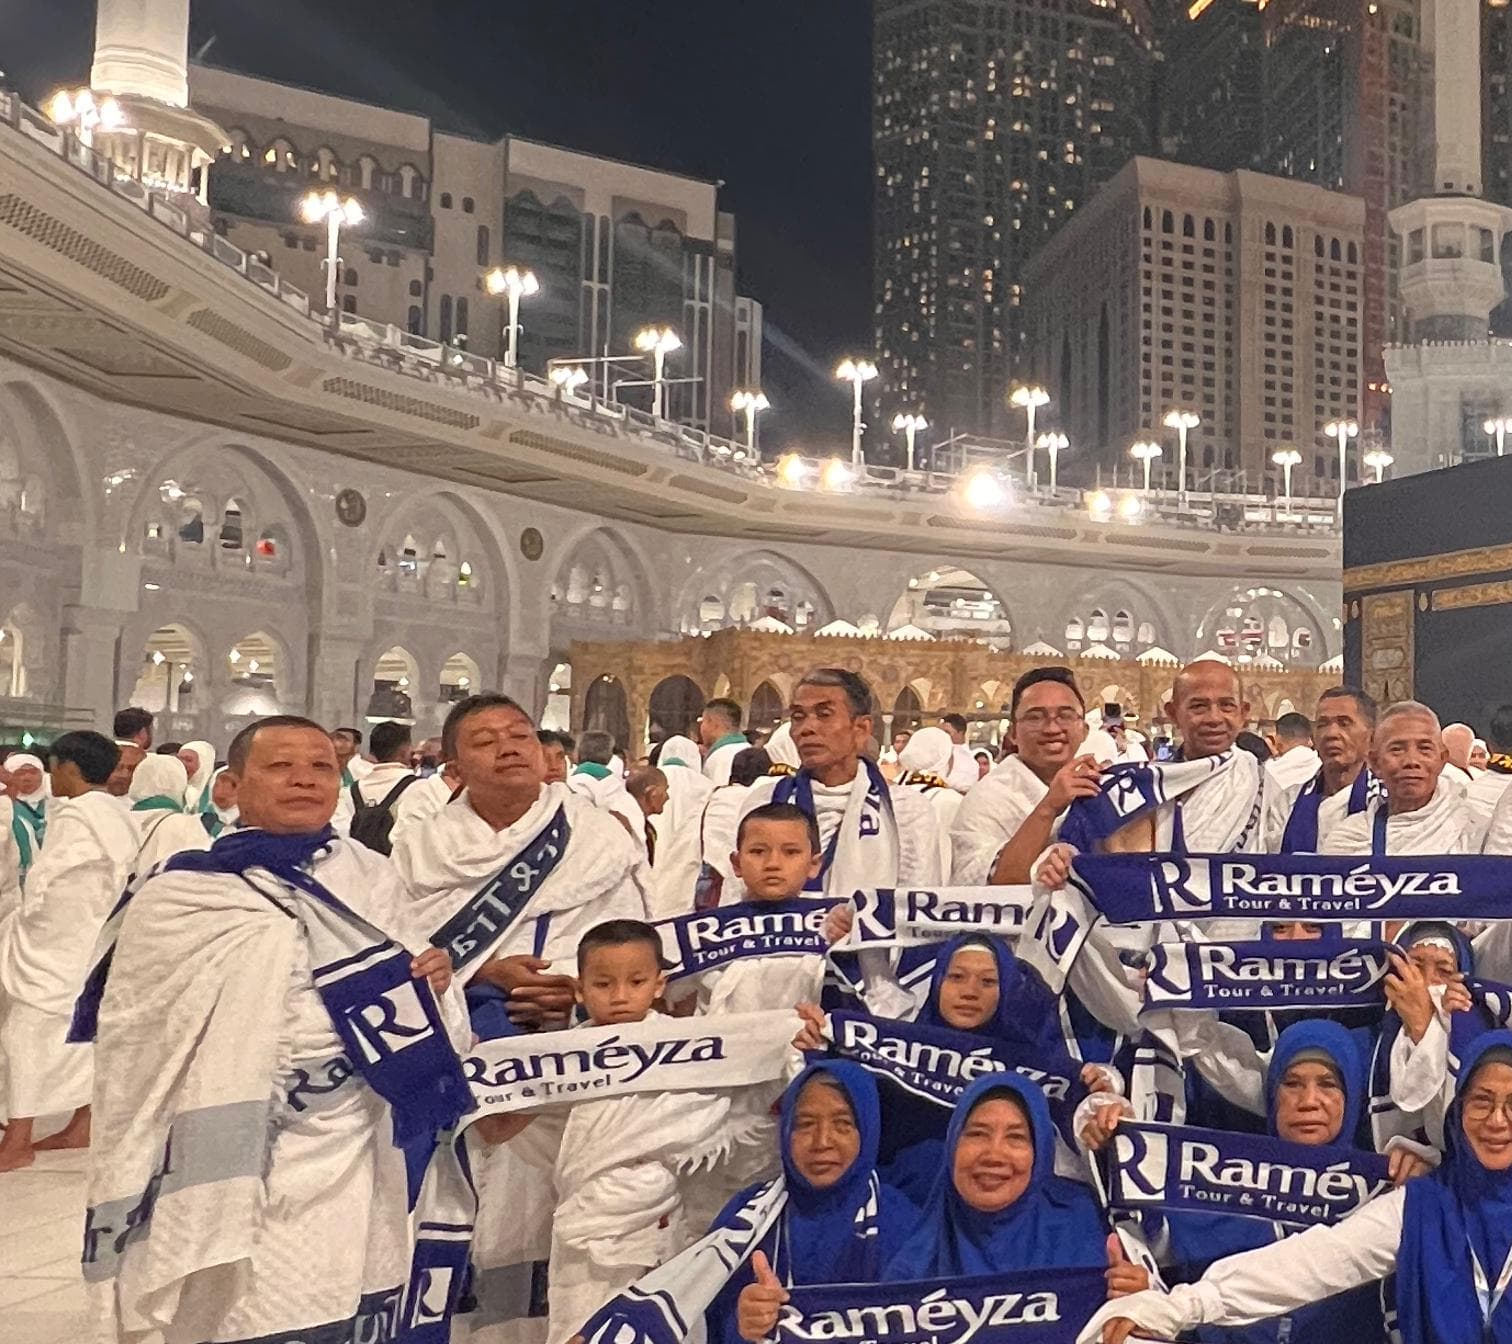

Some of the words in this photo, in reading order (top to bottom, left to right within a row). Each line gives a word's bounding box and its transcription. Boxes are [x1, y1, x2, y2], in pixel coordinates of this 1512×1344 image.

[1221, 863, 1463, 910] Raméyza
[905, 890, 1033, 925] Ram
[1222, 896, 1272, 910] Tour
[1279, 895, 1292, 909] &
[1297, 896, 1361, 911] Travel
[692, 943, 738, 965] Tour
[760, 933, 820, 949] Travel
[1204, 983, 1252, 998] Tour
[1260, 983, 1274, 998] &
[1279, 983, 1345, 998] Travel
[842, 1019, 1072, 1102] Raméza
[476, 1090, 513, 1105] our
[541, 1074, 612, 1097] Travel
[910, 1071, 964, 1097] Trave
[1179, 1183, 1232, 1204] Tour
[1239, 1191, 1254, 1205] &
[1261, 1194, 1330, 1219] Travel
